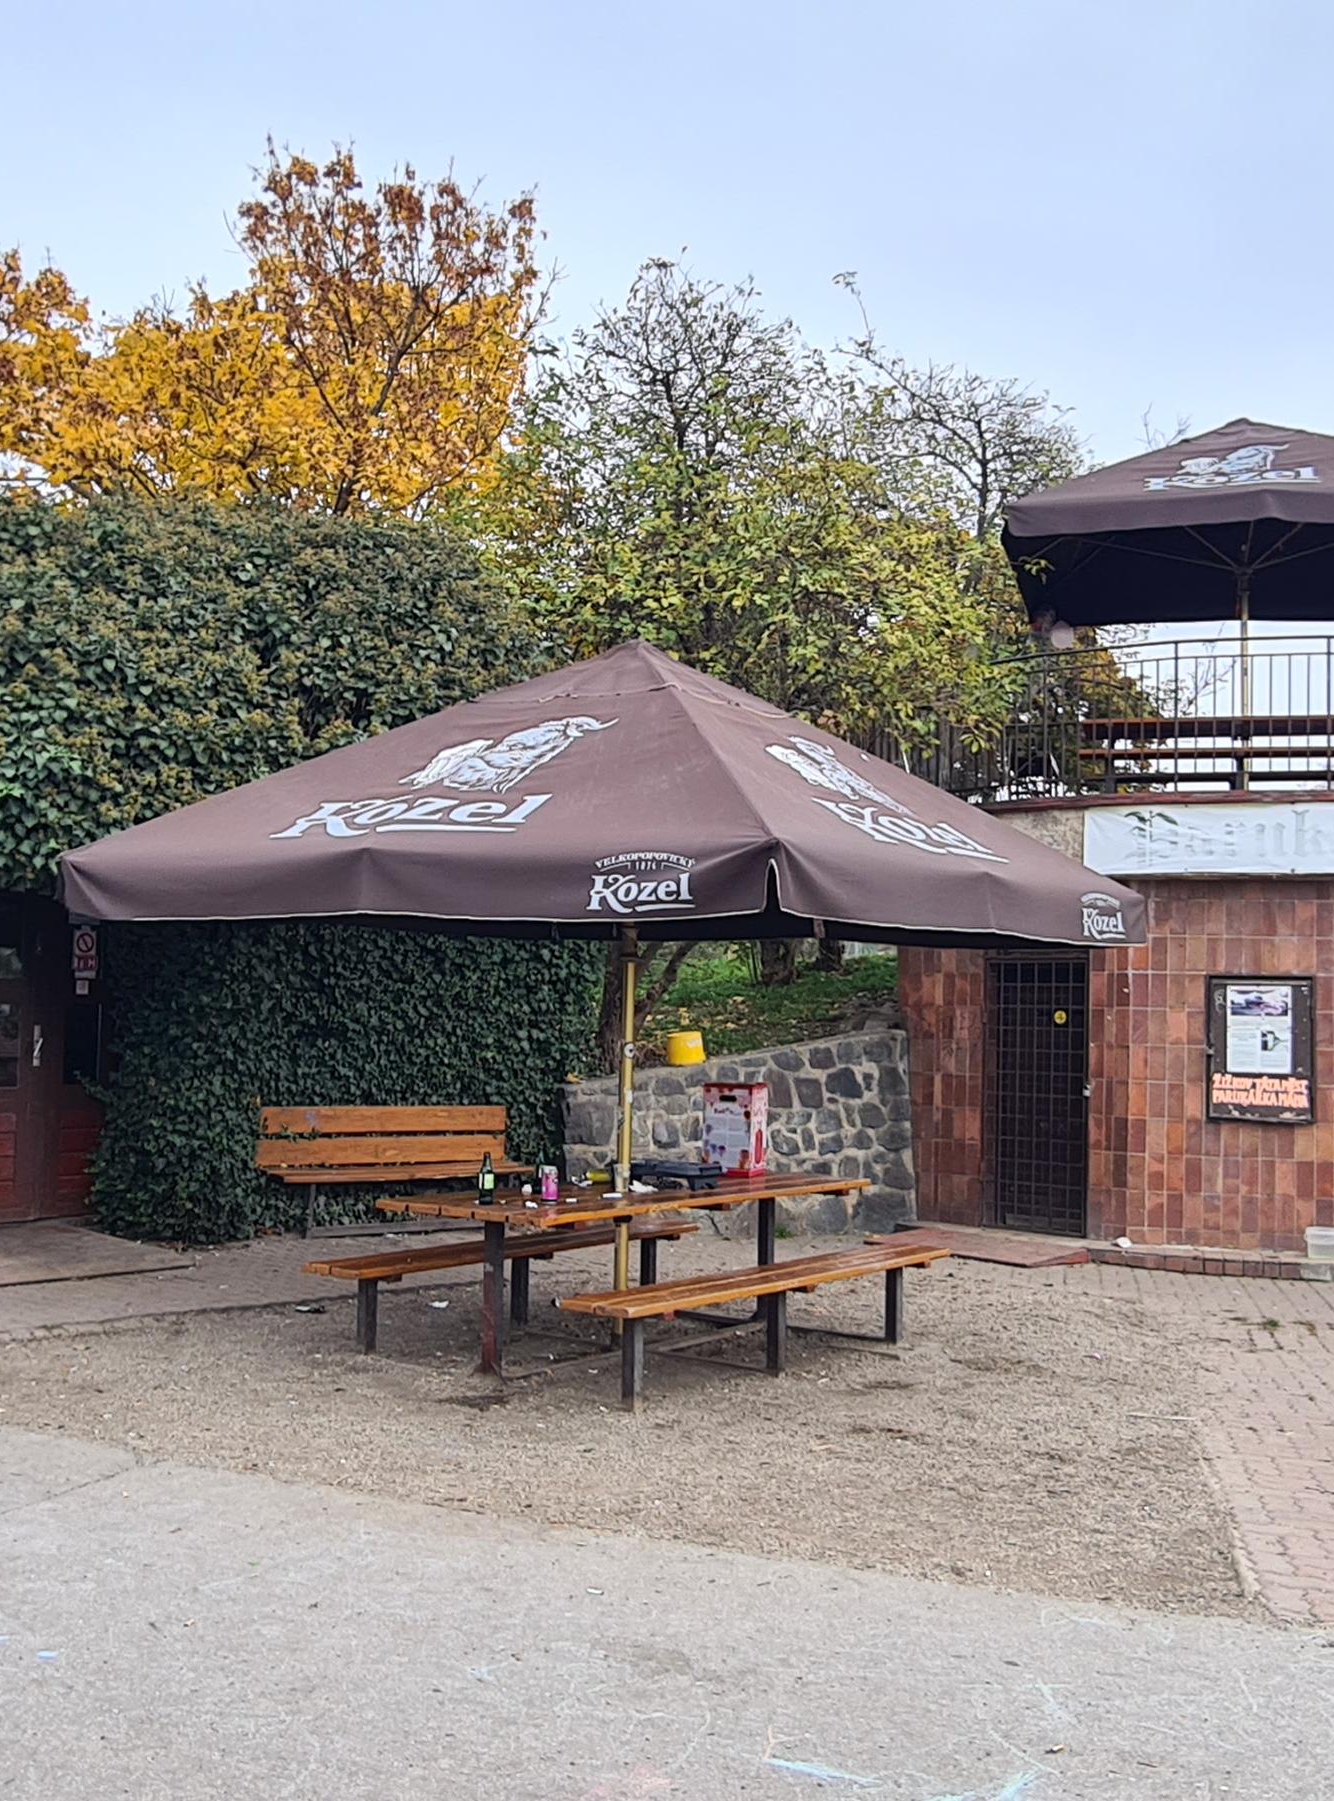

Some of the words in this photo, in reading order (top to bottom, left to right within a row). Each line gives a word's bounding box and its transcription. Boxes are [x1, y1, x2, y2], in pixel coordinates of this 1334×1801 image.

[1143, 466, 1321, 492] Kozel
[269, 792, 554, 840] Kozel
[811, 797, 1010, 864] Kozel
[595, 851, 696, 869] VELKOPOPOVICKÝ
[586, 872, 695, 914] Kozel
[1081, 907, 1126, 940] Kozel
